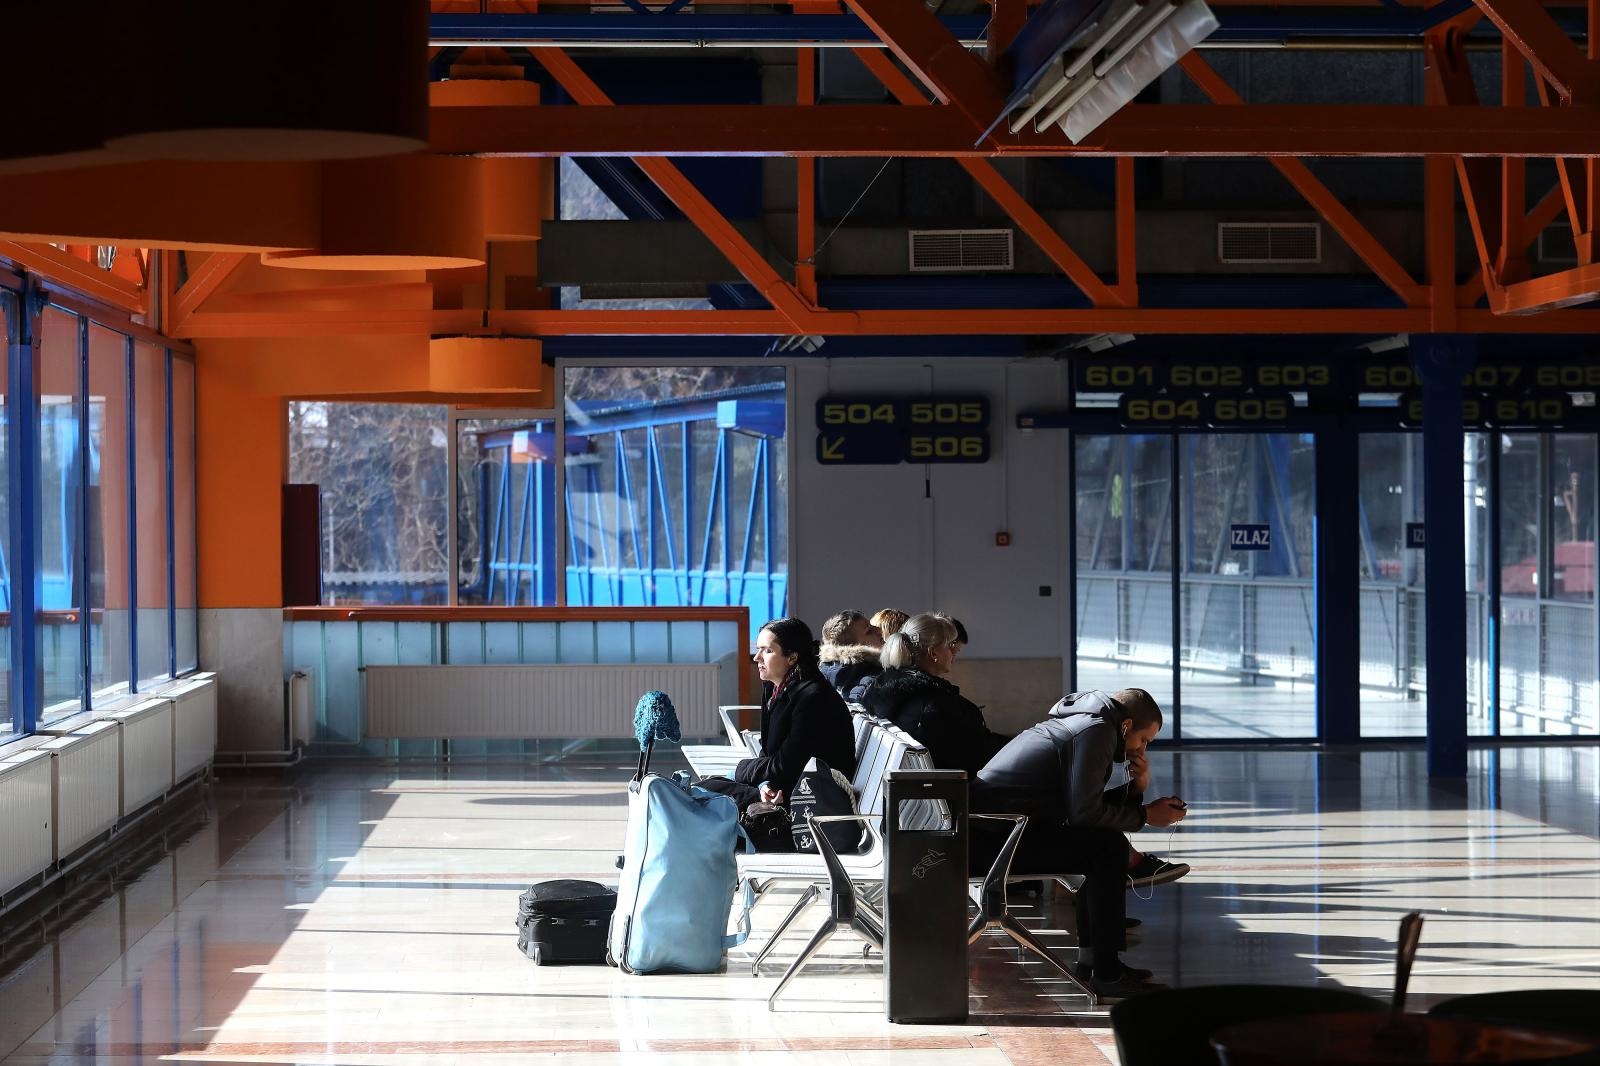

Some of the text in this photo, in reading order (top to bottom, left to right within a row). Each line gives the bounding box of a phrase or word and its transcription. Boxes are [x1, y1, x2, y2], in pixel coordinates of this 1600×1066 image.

[1085, 365, 1331, 387] 601 602 603
[1462, 365, 1521, 387] 07
[823, 403, 983, 425] 504 505
[1126, 399, 1288, 421] 604 605
[1497, 399, 1563, 421] 610
[910, 436, 984, 458] 506
[1231, 529, 1270, 545] IZLAZ
